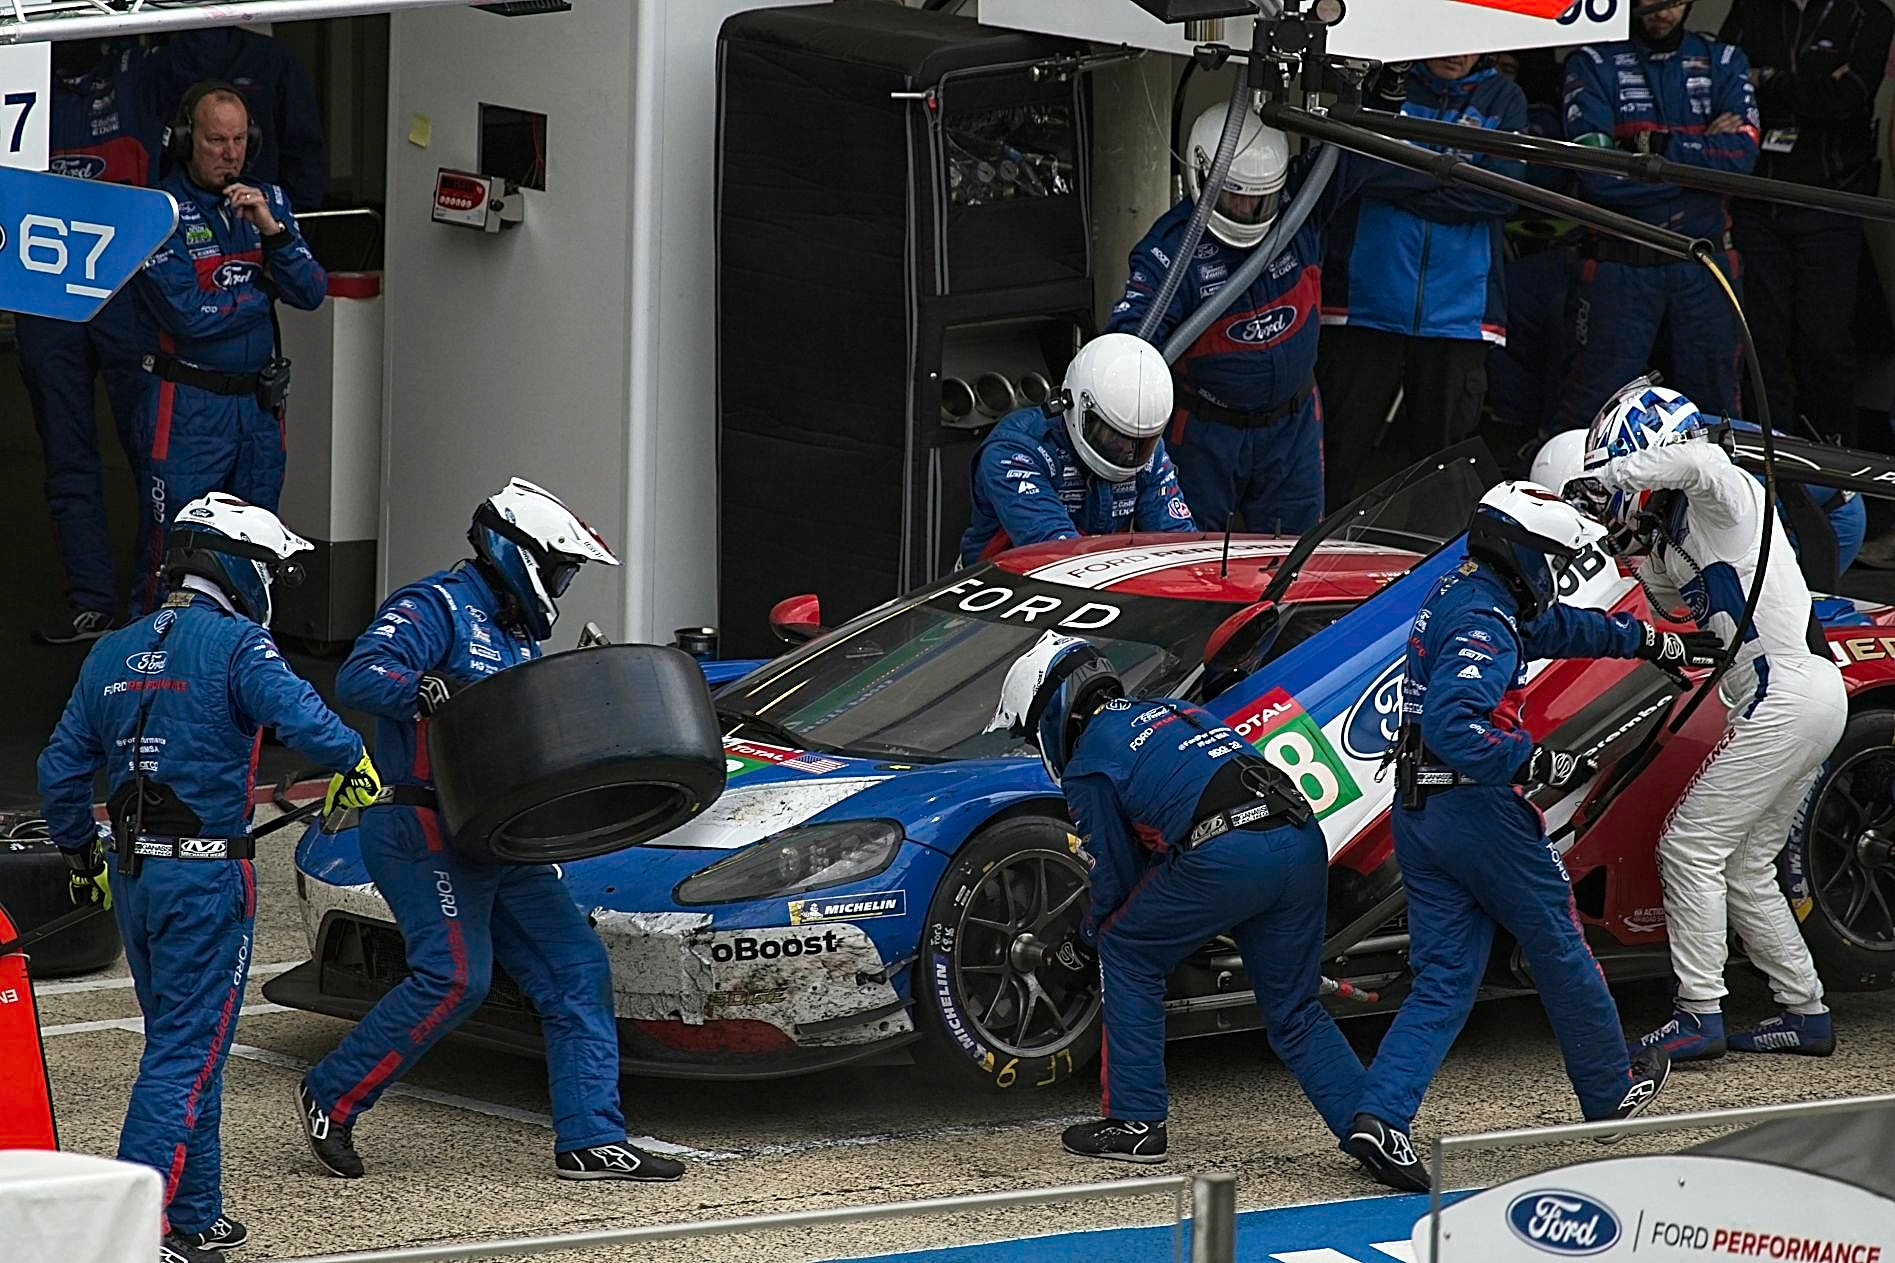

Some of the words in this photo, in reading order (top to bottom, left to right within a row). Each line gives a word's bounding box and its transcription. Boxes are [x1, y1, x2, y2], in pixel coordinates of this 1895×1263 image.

[4, 91, 37, 153] 7
[19, 213, 116, 281] 67
[1242, 312, 1286, 341] Ford
[152, 475, 166, 524] FORD
[1067, 555, 1148, 579] FORD
[928, 578, 1121, 629] FORD
[1129, 727, 1154, 752] FORD
[1234, 701, 1293, 738] OTAL
[731, 744, 784, 761] TOTAL
[1546, 841, 1571, 882] FORD
[433, 870, 459, 919] FORD
[824, 898, 898, 917] MICHELIN
[232, 934, 250, 987] FORD
[935, 963, 976, 1049] MICHELIN
[183, 986, 238, 1129] PERFORMANCE
[1753, 1030, 1801, 1049] PUMA
[1528, 1196, 1600, 1247] Ford
[1650, 1220, 1709, 1250] FORD
[1711, 1227, 1882, 1263] PERFORMANCE
